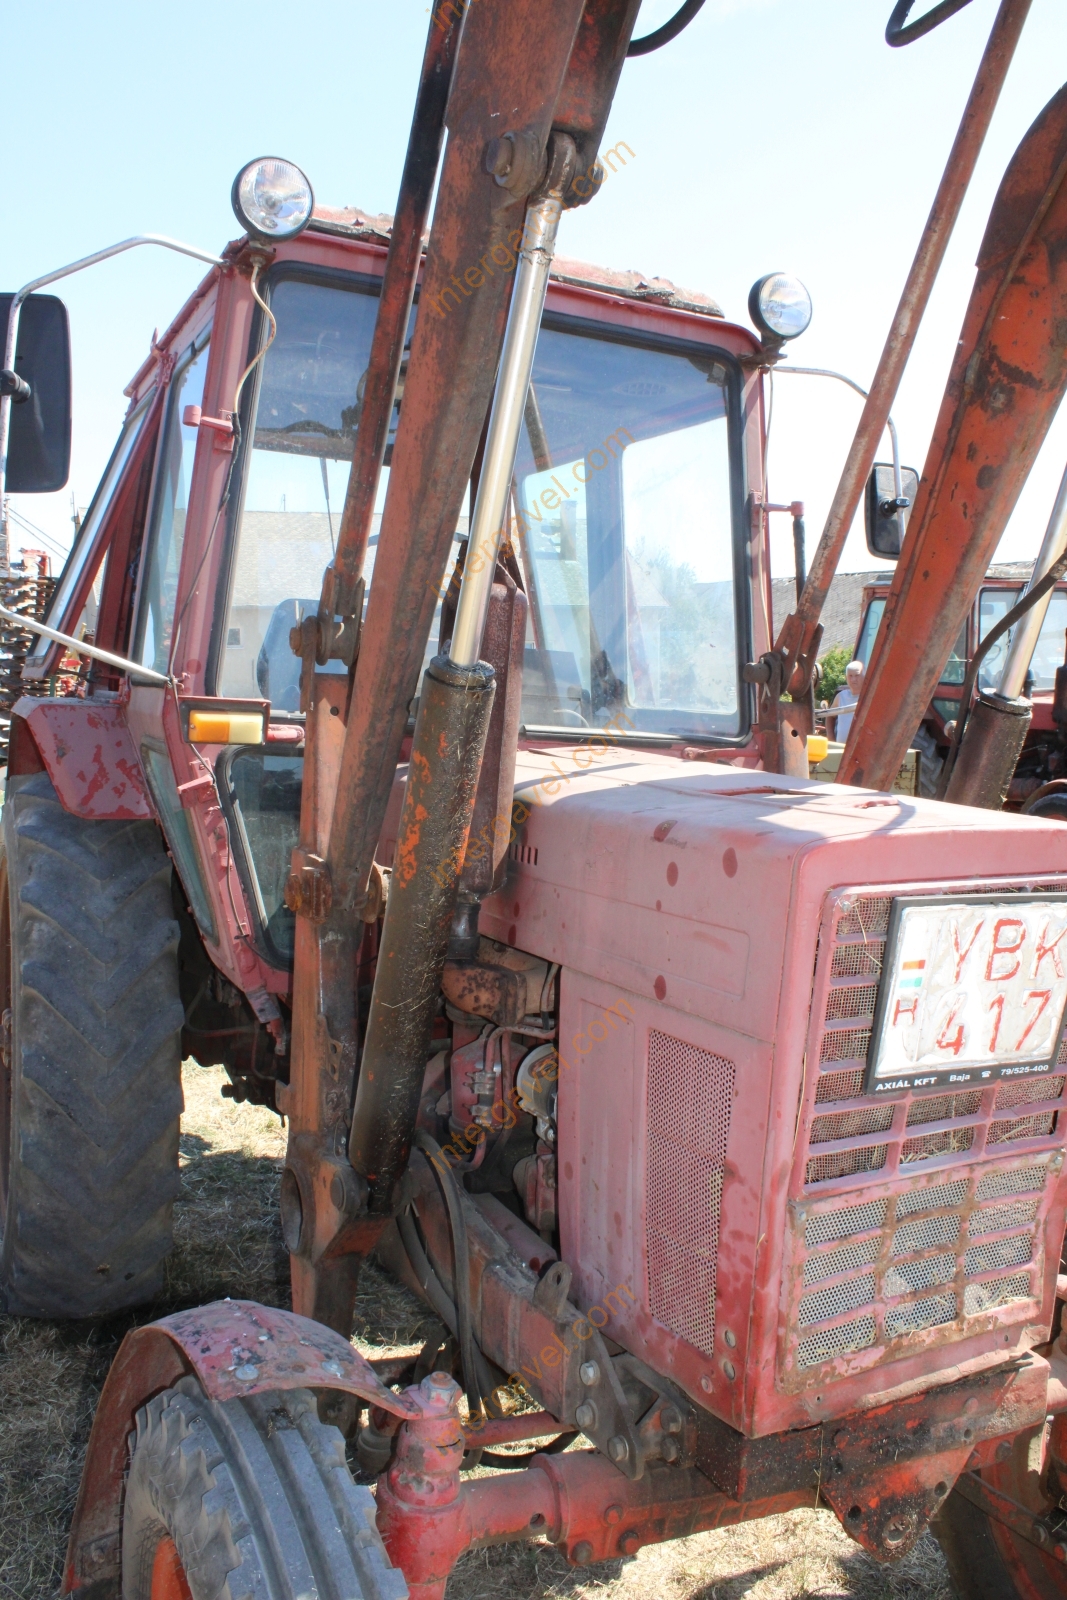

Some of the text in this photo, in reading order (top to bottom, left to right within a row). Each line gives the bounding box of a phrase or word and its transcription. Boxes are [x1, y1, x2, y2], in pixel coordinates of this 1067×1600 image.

[936, 989, 1052, 1056] 417
[875, 1064, 1049, 1091] AXIÁL KFT Baja 79/525-400
